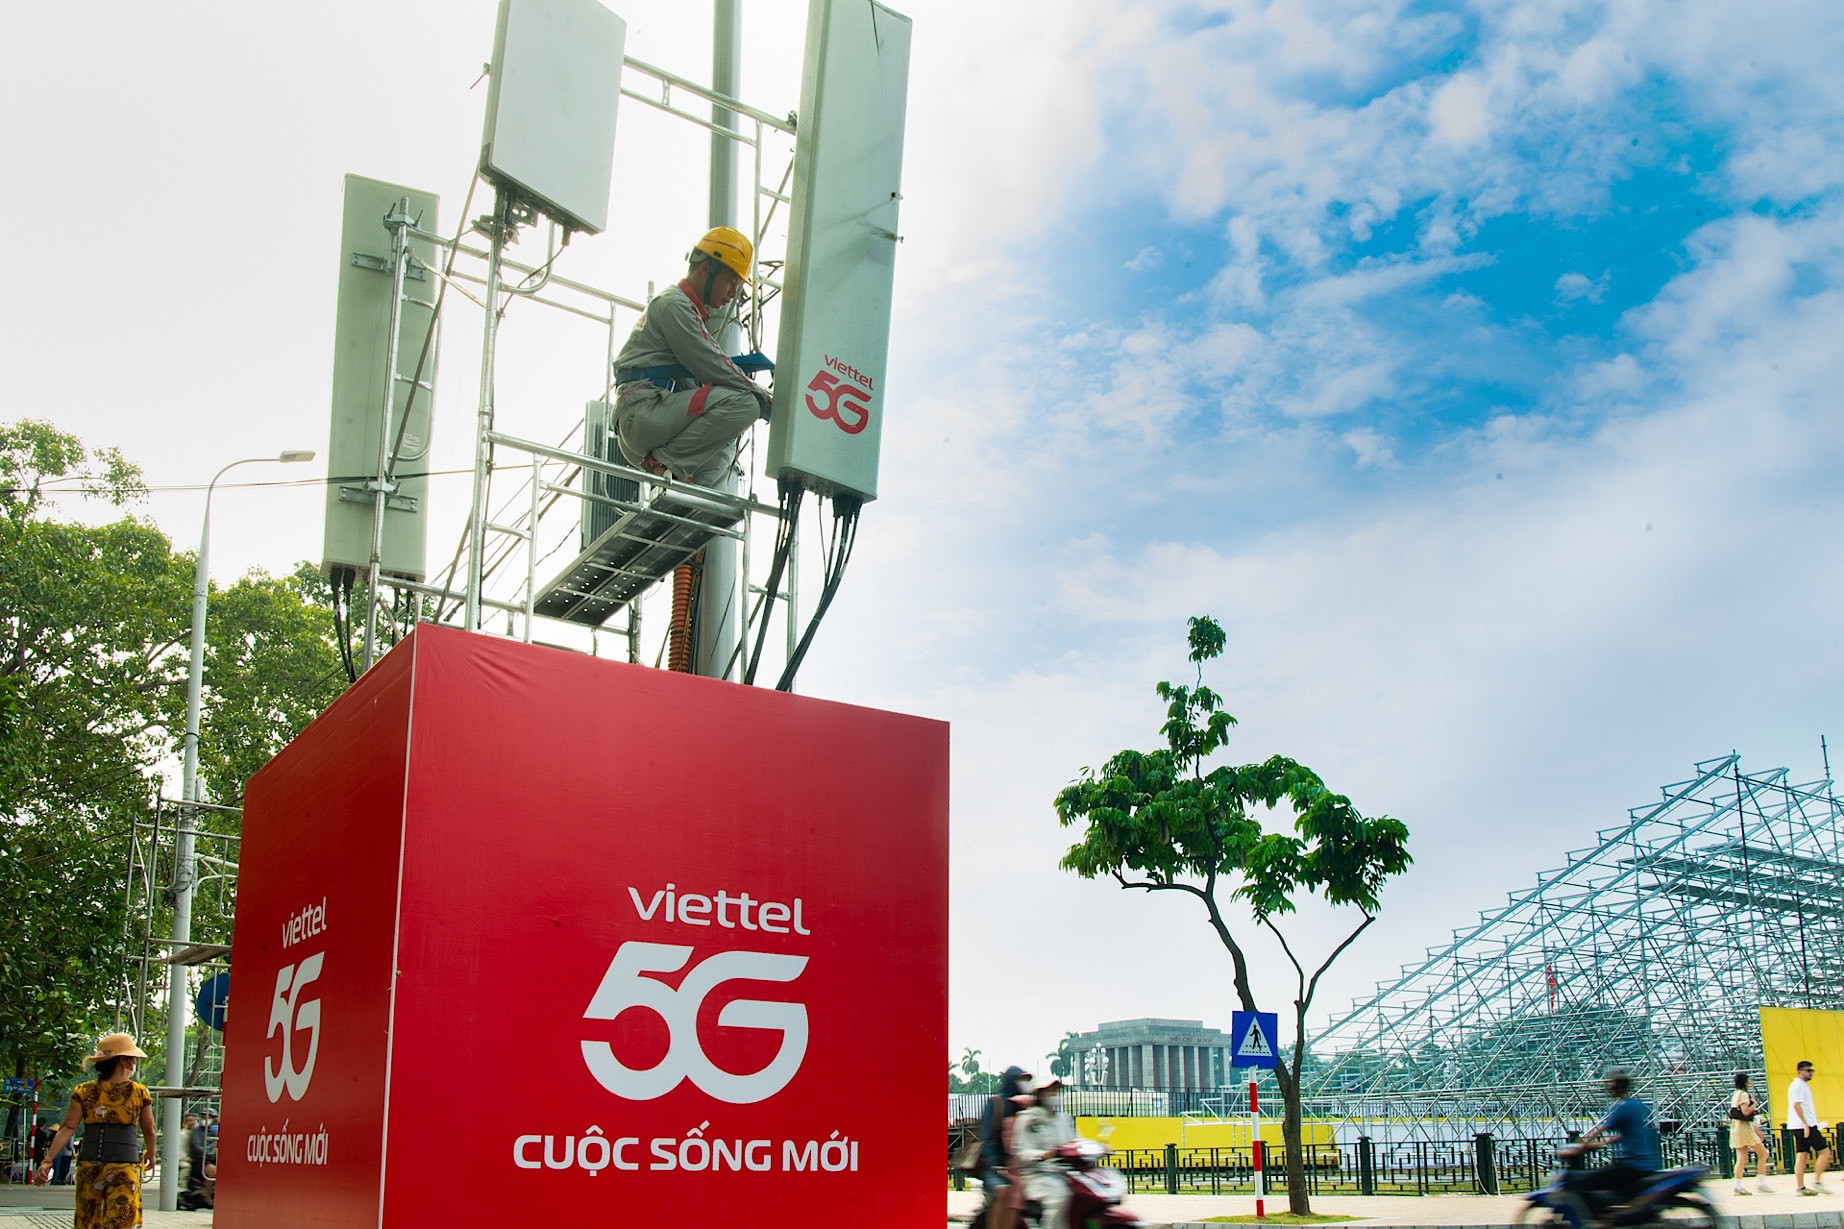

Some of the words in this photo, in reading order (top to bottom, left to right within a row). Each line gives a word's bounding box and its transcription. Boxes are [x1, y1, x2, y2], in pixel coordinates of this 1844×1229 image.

[824, 353, 875, 391] viettel
[804, 369, 873, 435] 5G
[281, 896, 328, 949] viettel
[628, 882, 811, 936] viettel
[264, 950, 325, 1104] 5G
[580, 940, 810, 1105] 5G
[247, 1125, 273, 1168] CUỘC
[273, 1118, 304, 1165] SỐNG
[304, 1121, 329, 1166] MỚI
[513, 1124, 640, 1177] CUỘC
[649, 1119, 772, 1172] SỐNG
[782, 1129, 859, 1172] MỚI
